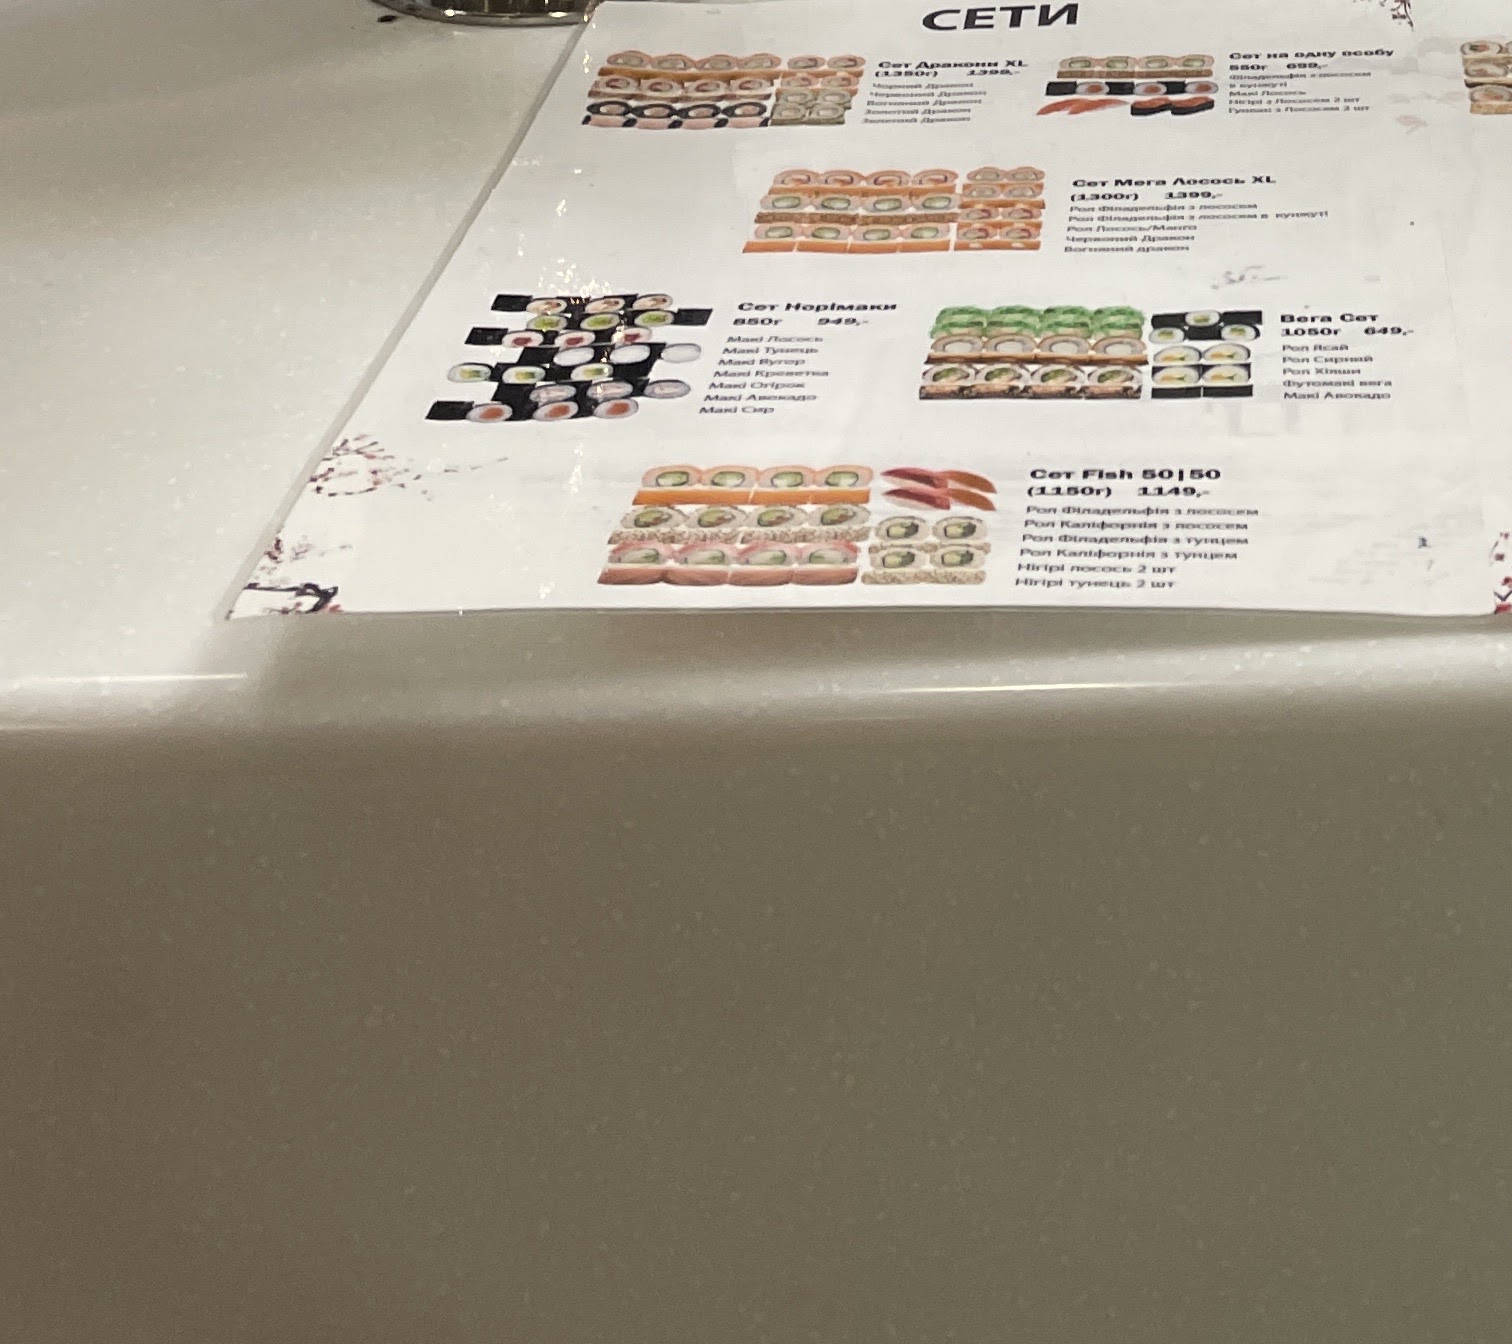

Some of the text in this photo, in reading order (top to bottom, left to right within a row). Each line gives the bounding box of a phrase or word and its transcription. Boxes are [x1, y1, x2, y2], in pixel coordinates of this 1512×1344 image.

[922, 2, 1079, 31] СЕТИ
[1229, 52, 1262, 60] Сет
[1294, 51, 1336, 59] одну
[1341, 48, 1394, 58] особу
[1072, 175, 1277, 188] Сет Мега Лосось XL
[737, 301, 898, 313] Сет Норімаки
[1280, 313, 1379, 323] Вега Сет
[1029, 468, 1076, 480] Сет
[1081, 468, 1133, 480] Fish
